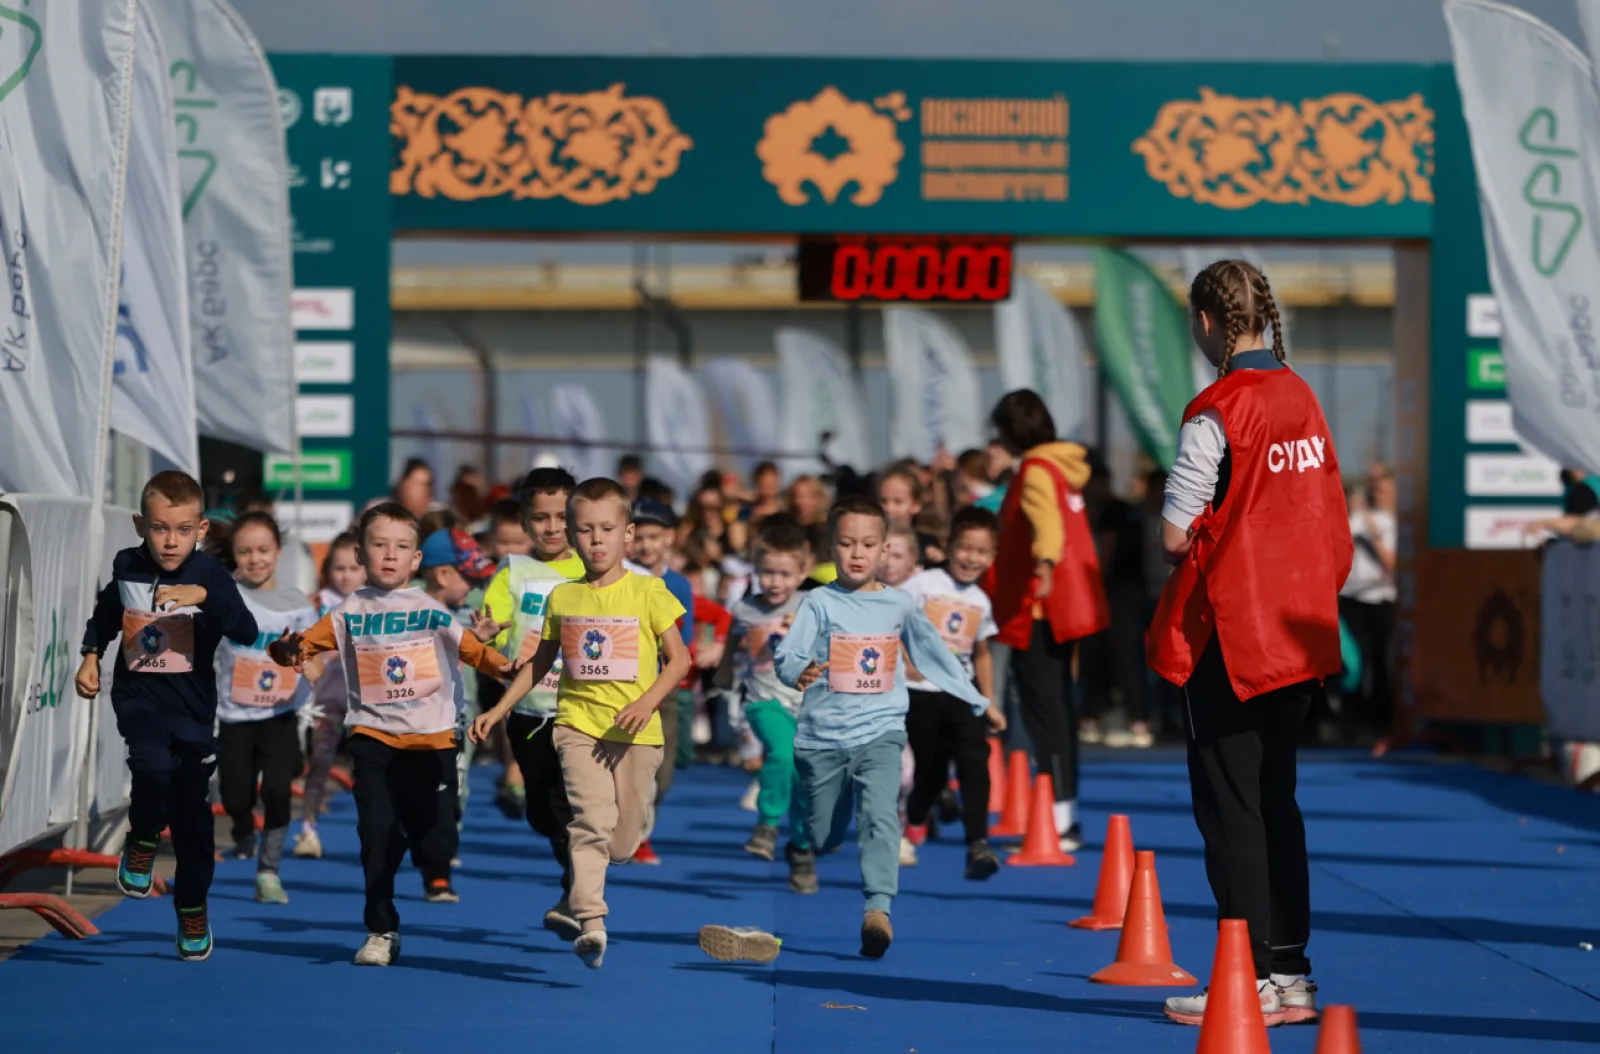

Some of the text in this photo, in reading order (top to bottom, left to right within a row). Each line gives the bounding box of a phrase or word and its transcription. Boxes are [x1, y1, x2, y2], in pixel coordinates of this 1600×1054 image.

[831, 244, 1012, 300] 0:00:00
[344, 609, 453, 636] СИБУР
[580, 665, 610, 675] 3565
[856, 679, 882, 689] 3658
[387, 687, 415, 699] 3326
